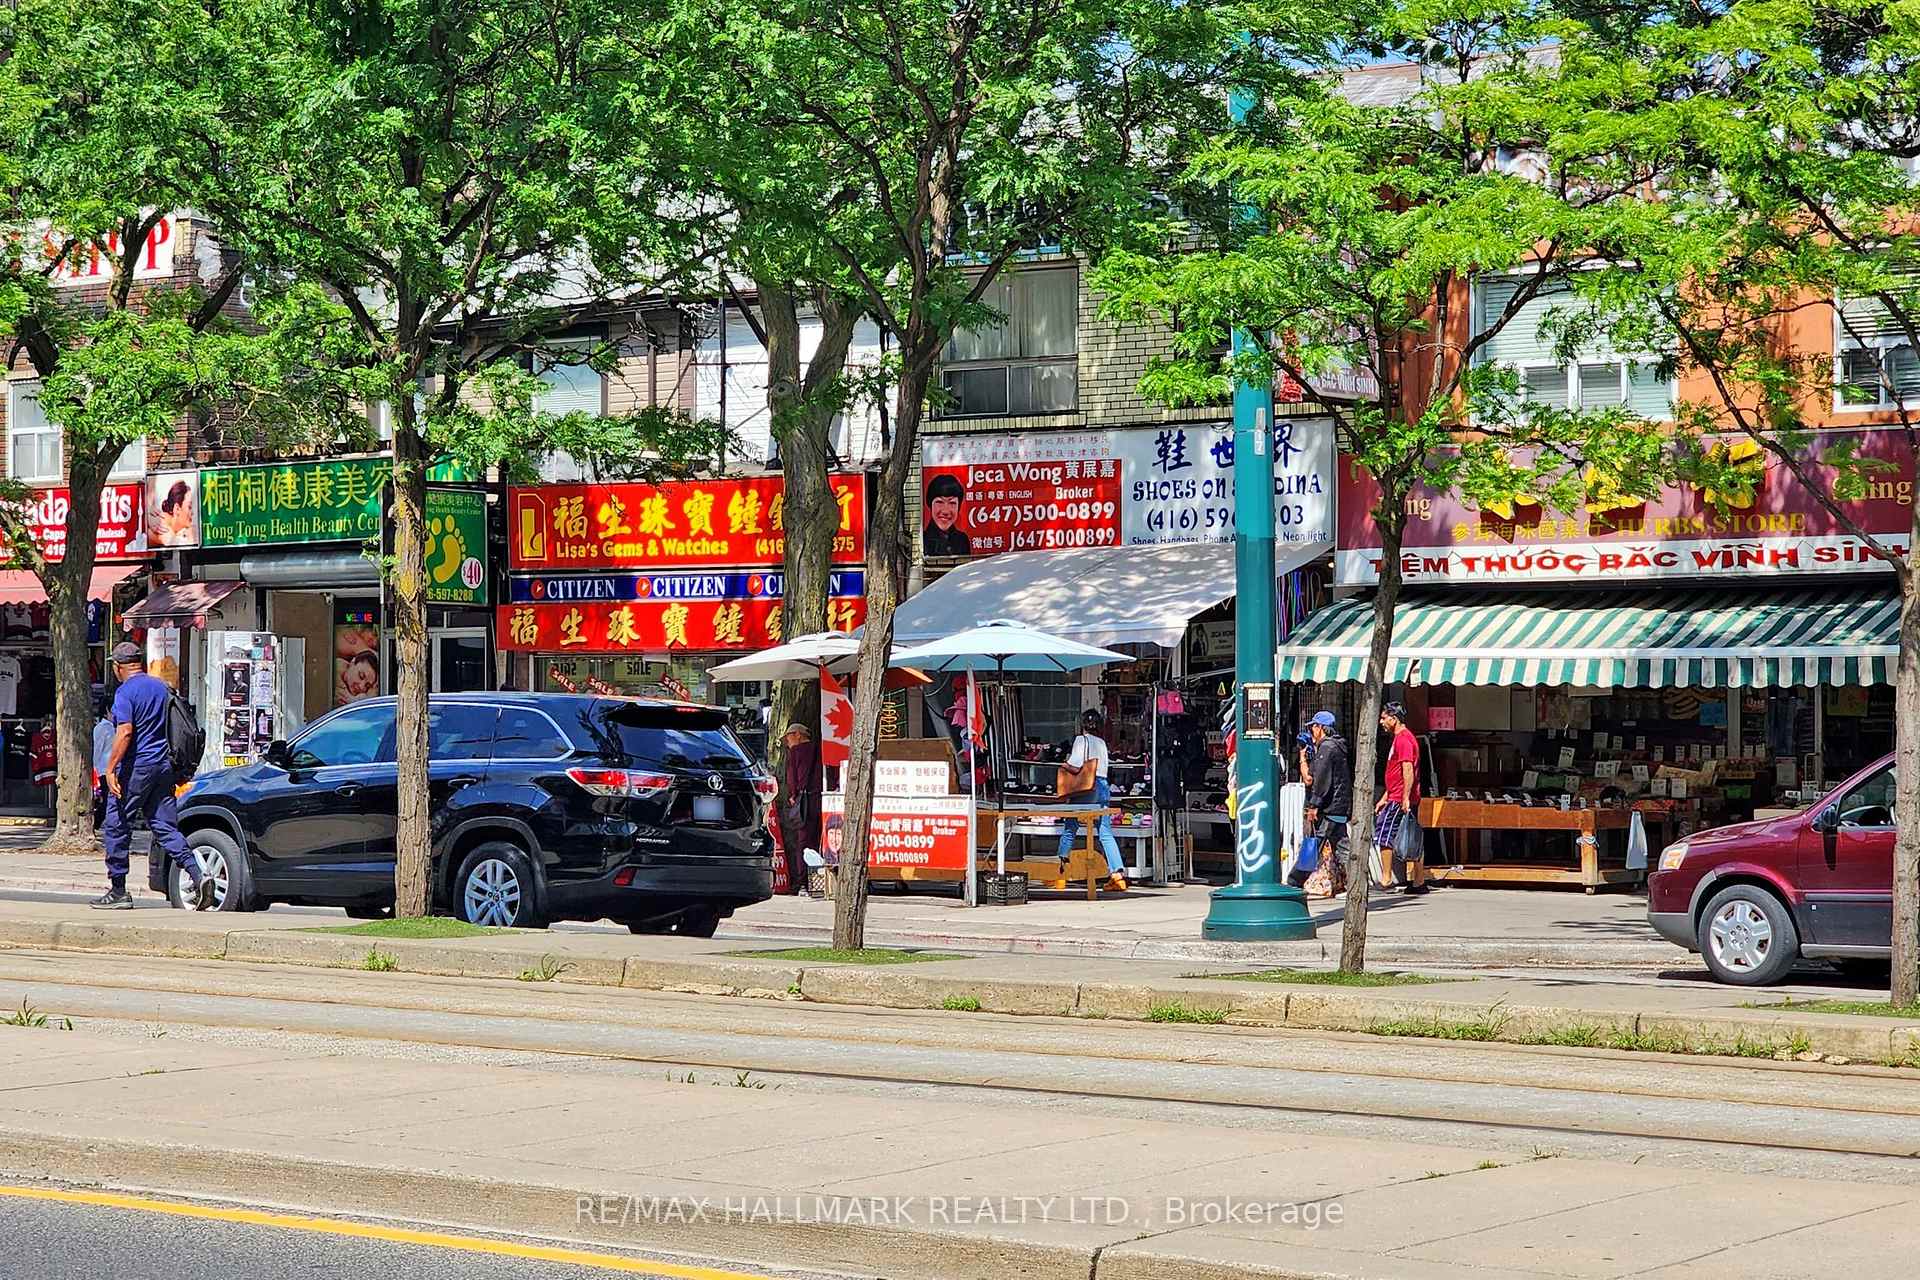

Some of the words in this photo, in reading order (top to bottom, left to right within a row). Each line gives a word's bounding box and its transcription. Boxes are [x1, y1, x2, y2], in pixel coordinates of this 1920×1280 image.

[966, 465, 1005, 489] Jeca
[1007, 463, 1063, 485] Wong
[1133, 479, 1196, 501] SHOES
[1202, 477, 1227, 499] ON
[1232, 473, 1322, 498] DINA
[1055, 486, 1093, 500] Broker
[203, 522, 234, 542] Tong
[236, 520, 267, 541] Tong
[271, 517, 308, 536] Health
[313, 516, 354, 536] Beauty
[357, 512, 381, 531] Cen
[968, 501, 1116, 529] (647)500-0899
[1146, 507, 1199, 531] (416)
[1712, 511, 1807, 535] STORE
[556, 541, 598, 558] Lisa's
[603, 540, 643, 557] Gems
[647, 539, 658, 556] &
[662, 537, 729, 556] Watches
[1009, 527, 1116, 552] J6475000899
[547, 578, 616, 599] CITIZEN
[652, 576, 726, 597] CITIZEN
[510, 601, 857, 648] 福生珠寶鐘行
[552, 670, 576, 692] SALE
[870, 815, 890, 833] ong
[932, 825, 957, 836] Broker
